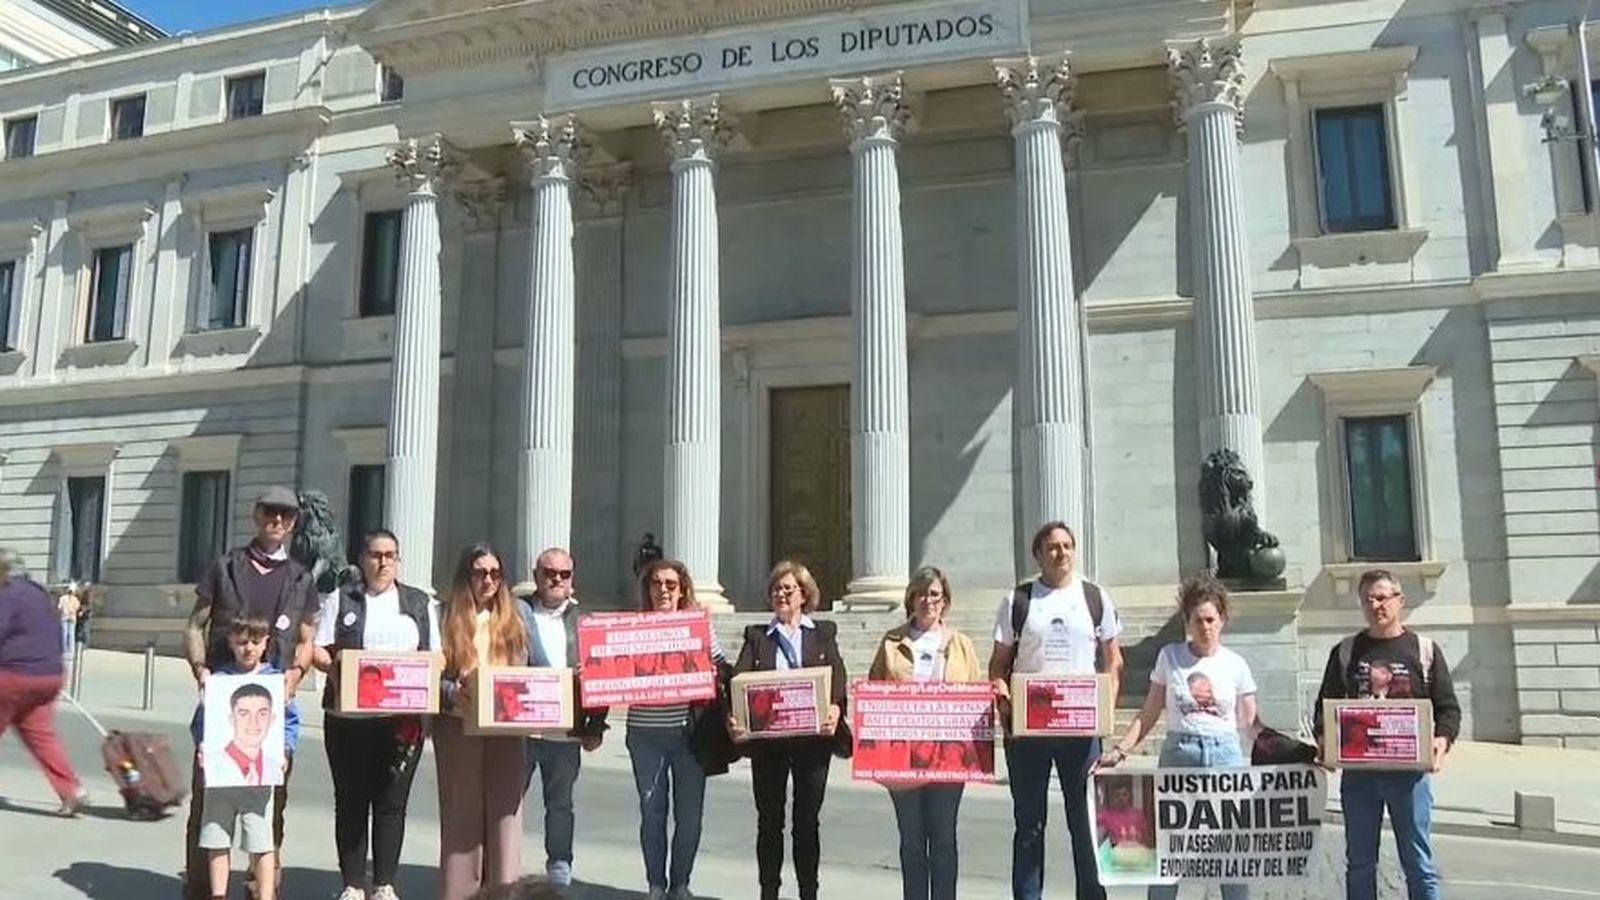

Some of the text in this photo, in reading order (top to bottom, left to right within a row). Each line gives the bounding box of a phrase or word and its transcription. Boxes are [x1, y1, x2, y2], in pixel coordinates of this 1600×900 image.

[573, 14, 994, 89] CONGRESO DE LOS DIPUTADOS
[1158, 770, 1318, 793] JUSTICIA PARA
[1159, 796, 1321, 830] DANIEL
[1169, 832, 1313, 852] UN ASESINO NO TIENE EDAD
[1160, 858, 1223, 878] ENDURECER
[1226, 858, 1239, 877] LA
[1241, 857, 1262, 877] LEY
[1264, 857, 1284, 876] DEL
